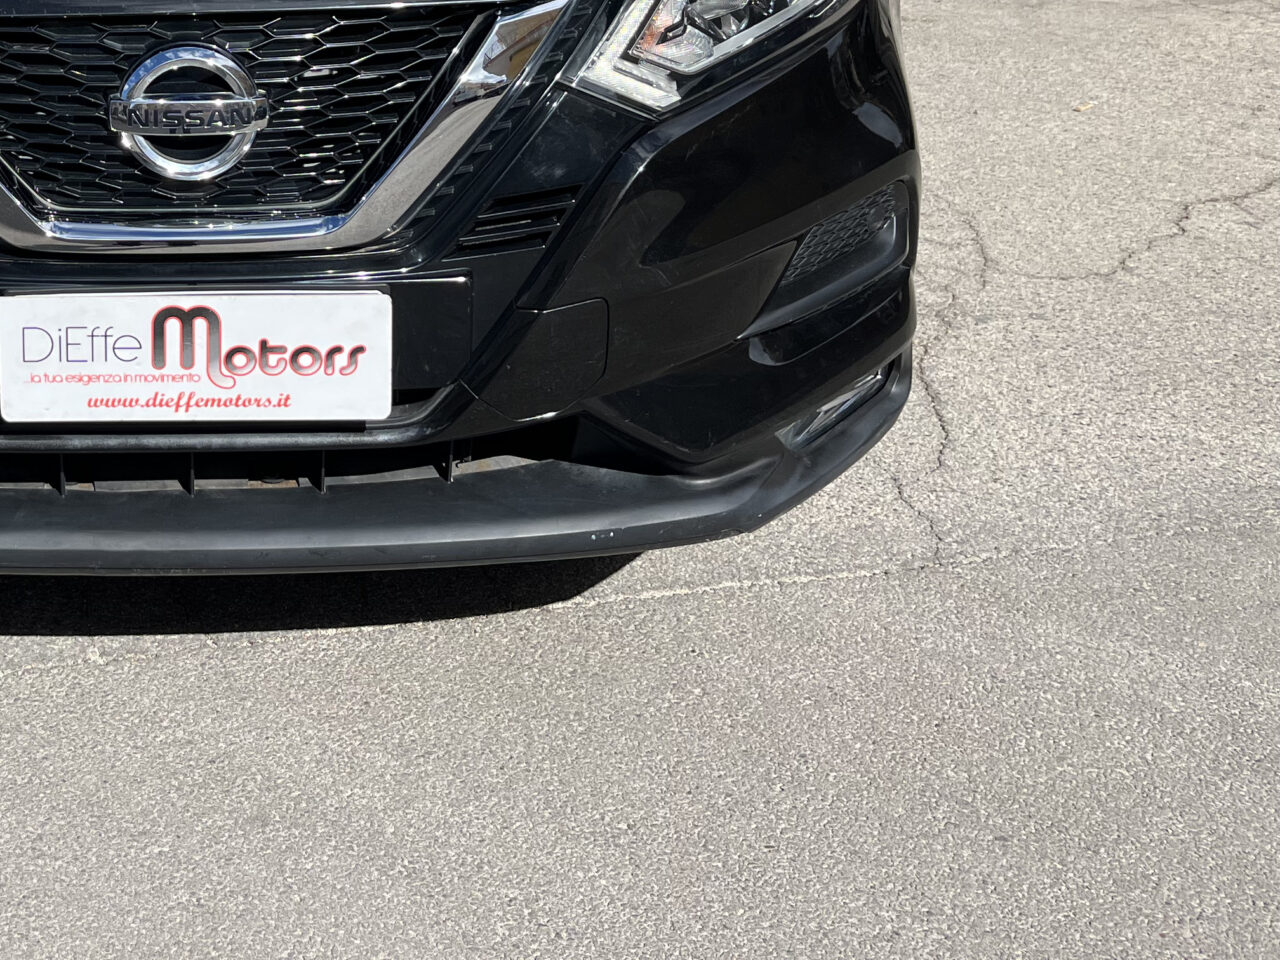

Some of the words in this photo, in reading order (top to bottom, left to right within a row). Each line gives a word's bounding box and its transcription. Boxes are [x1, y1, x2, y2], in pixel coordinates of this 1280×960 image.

[127, 108, 252, 128] NISSAN
[22, 326, 142, 363] DiEffe
[151, 304, 367, 390] Motors
[43, 372, 63, 383] tua
[65, 372, 122, 386] esigenza
[123, 372, 133, 383] in
[134, 372, 201, 383] movimento
[87, 391, 291, 413] www.dieffemotors.it
